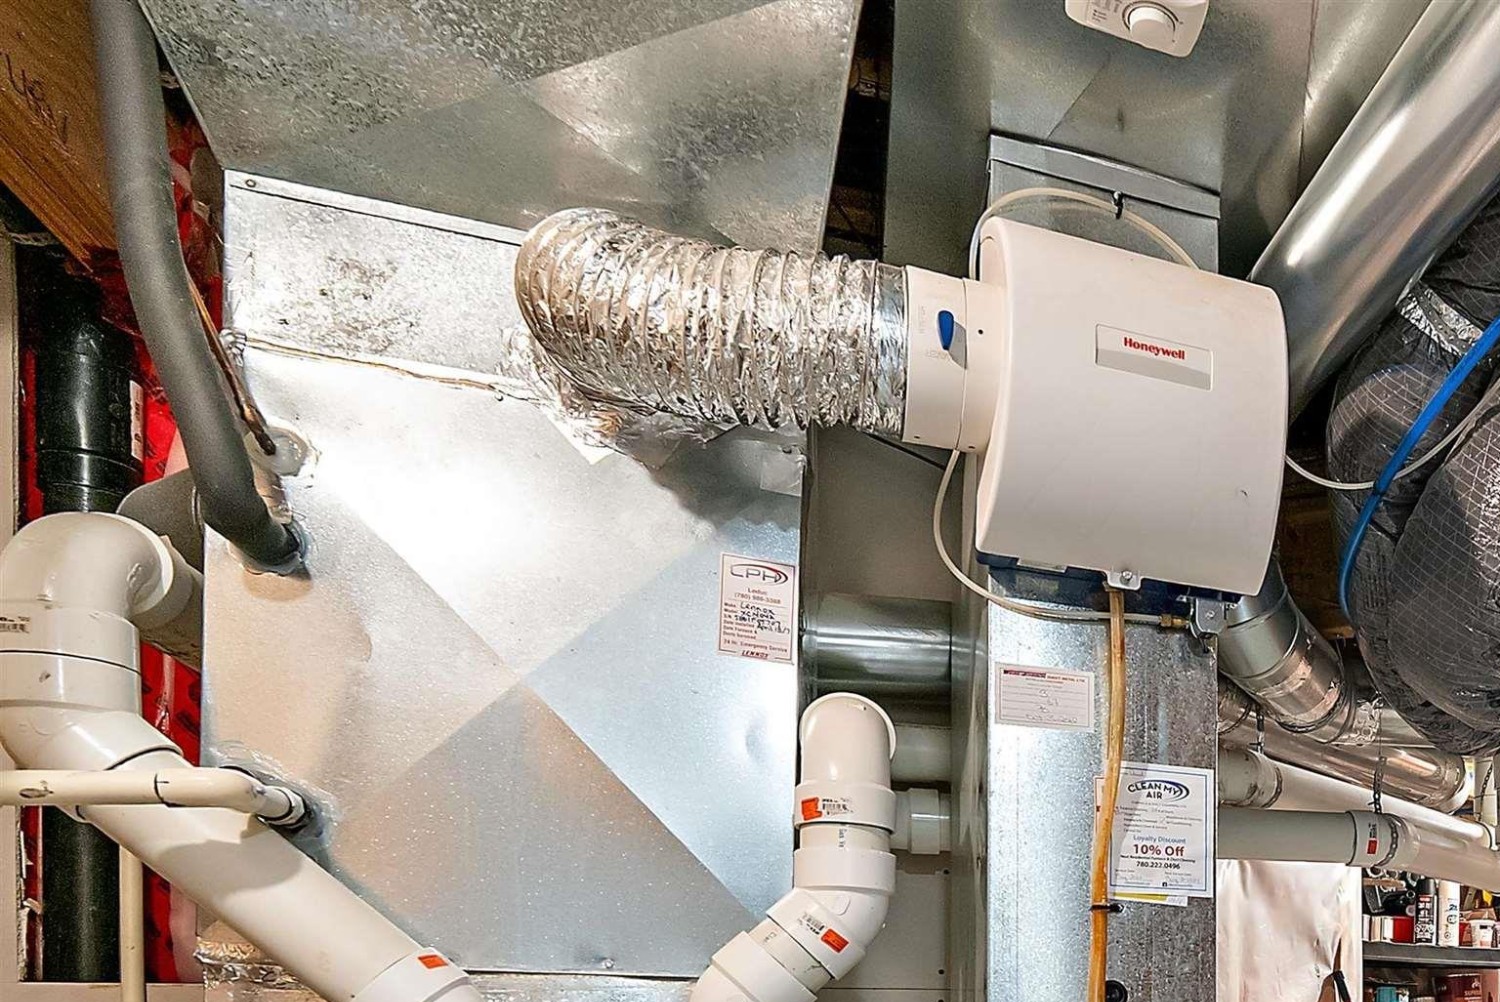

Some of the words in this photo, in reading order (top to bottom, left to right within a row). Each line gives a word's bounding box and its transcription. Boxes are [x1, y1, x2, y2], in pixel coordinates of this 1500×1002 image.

[1123, 337, 1185, 360] Honeywell
[1128, 783, 1161, 793] CLEAN
[1163, 784, 1180, 795] MY
[1146, 791, 1162, 799] AIR
[1133, 834, 1156, 843] Loyalty
[1158, 836, 1186, 844] Discount
[1133, 844, 1161, 856] 10%
[1165, 846, 1185, 857] Off
